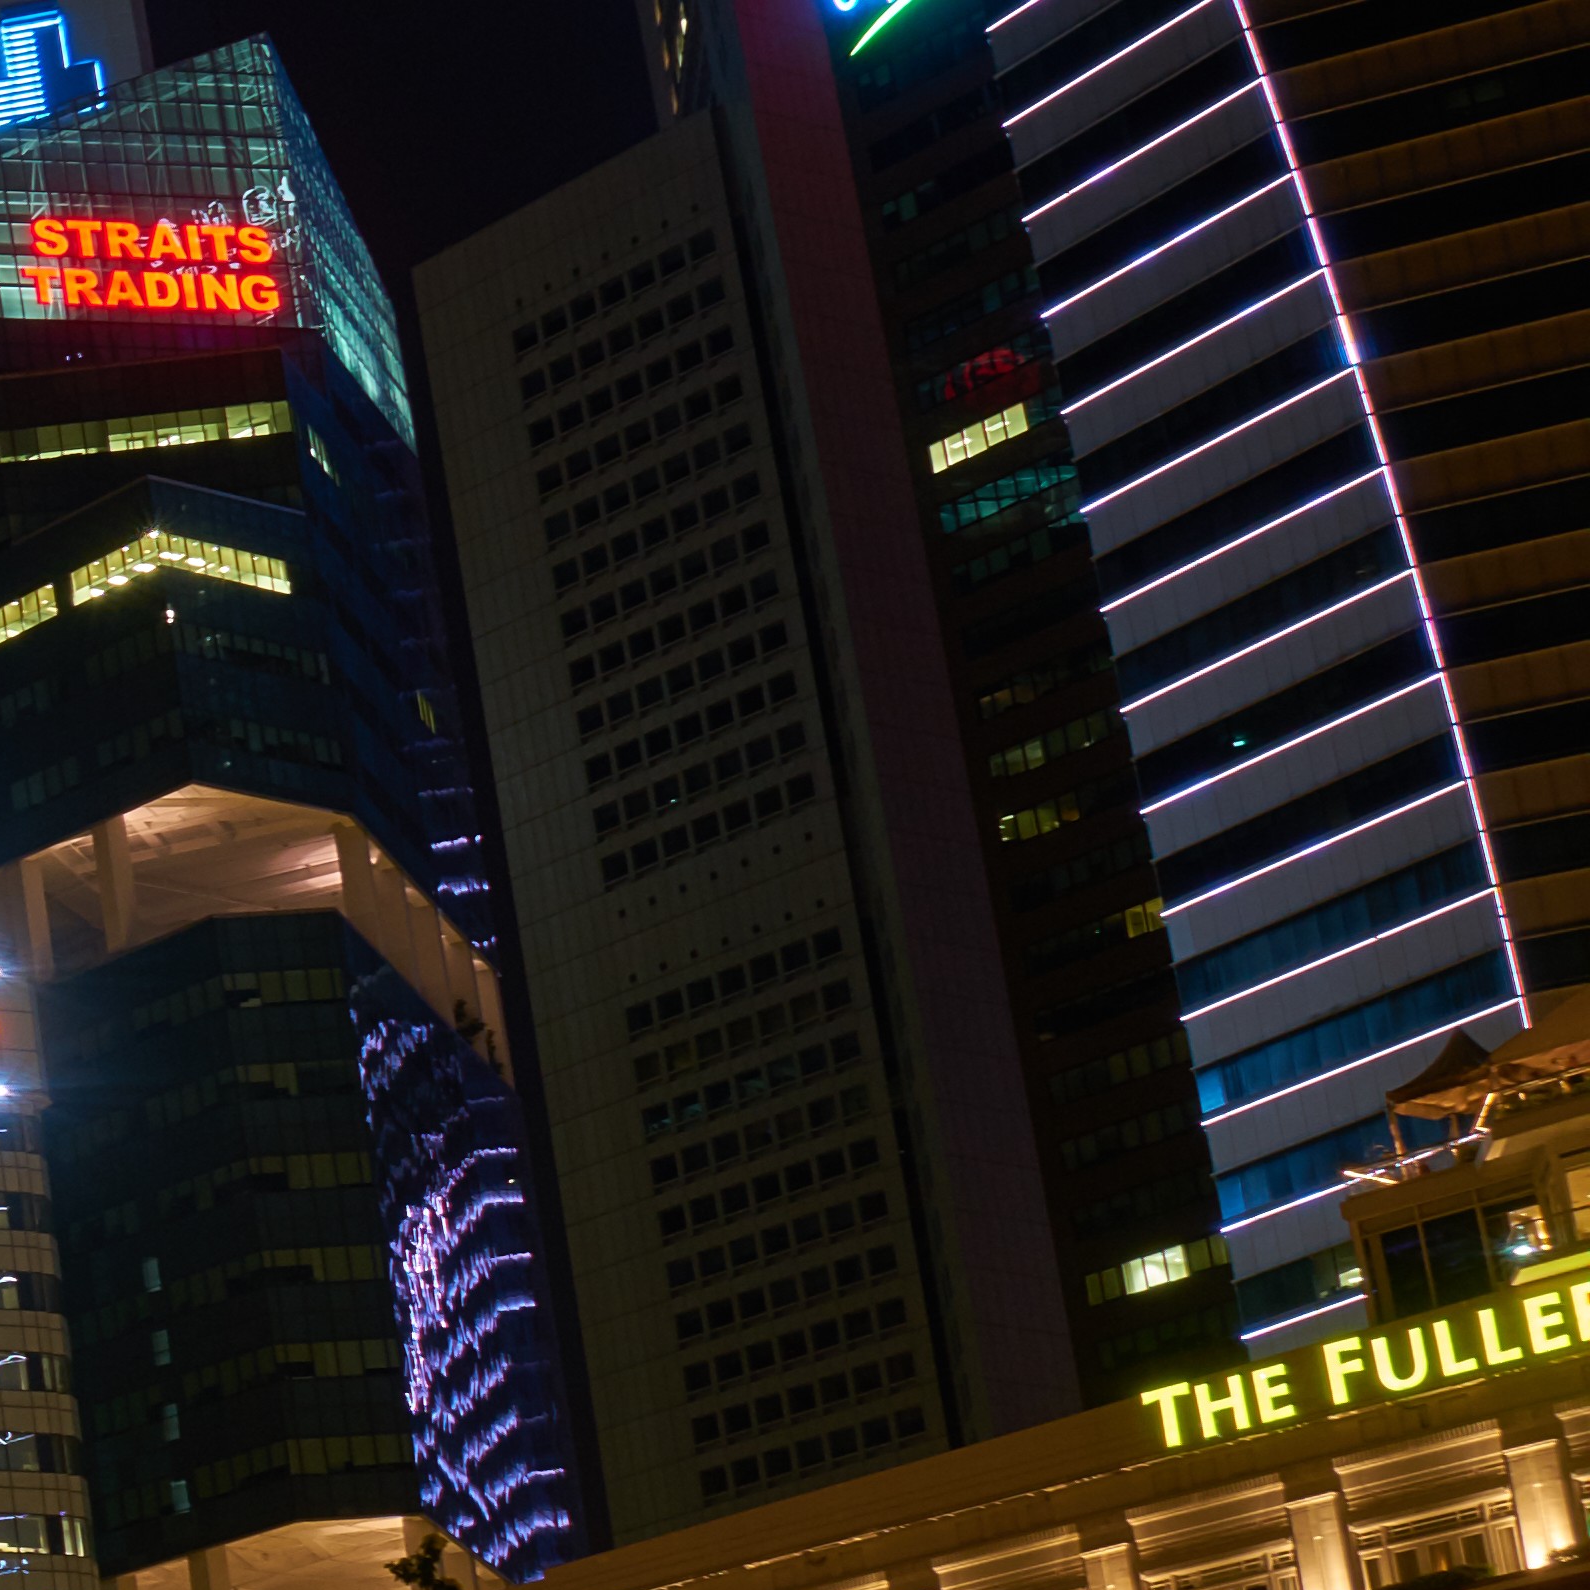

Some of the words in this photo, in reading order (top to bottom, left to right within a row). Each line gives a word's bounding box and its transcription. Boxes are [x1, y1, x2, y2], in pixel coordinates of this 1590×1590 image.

[31, 219, 274, 264] STRAITS
[21, 266, 281, 312] TRADING
[1140, 1363, 1298, 1449] THE
